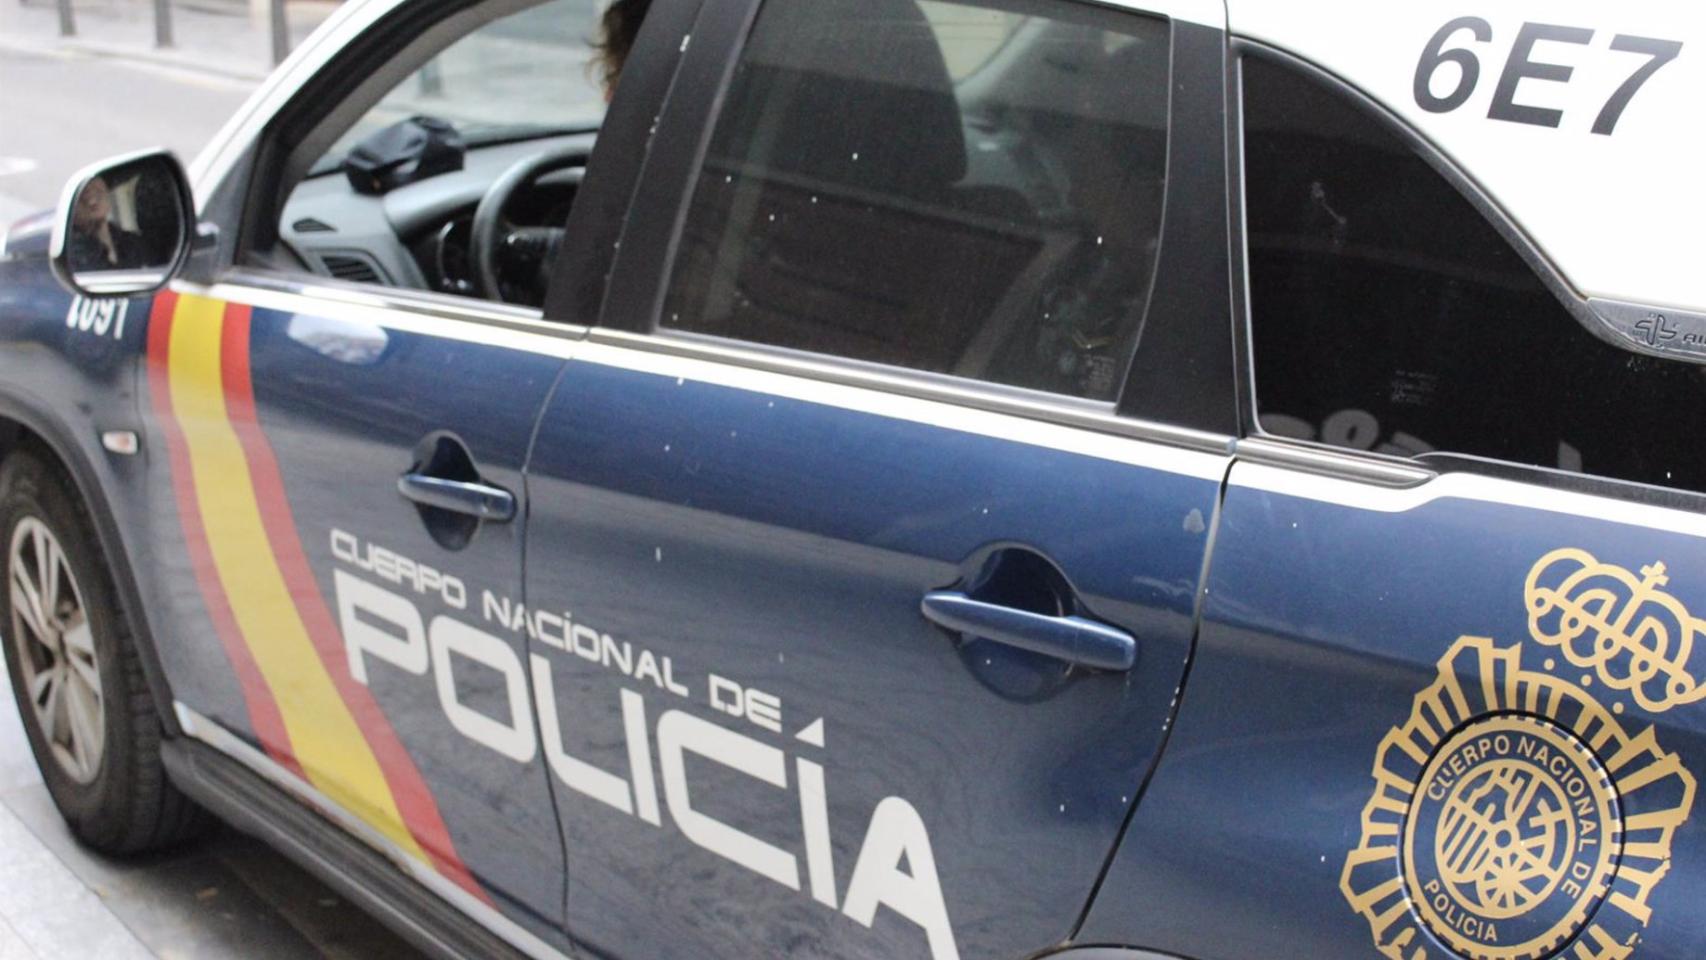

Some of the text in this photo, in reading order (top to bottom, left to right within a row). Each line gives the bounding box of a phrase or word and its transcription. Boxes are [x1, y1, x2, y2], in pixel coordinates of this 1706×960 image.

[1412, 16, 1684, 137] 6E7
[329, 527, 467, 610] CUERPO
[708, 674, 783, 734] DE
[333, 567, 962, 960] POLICÍA
[1427, 734, 1598, 900] CUERPO NACIONAL DE
[1423, 879, 1498, 943] POLICIA
